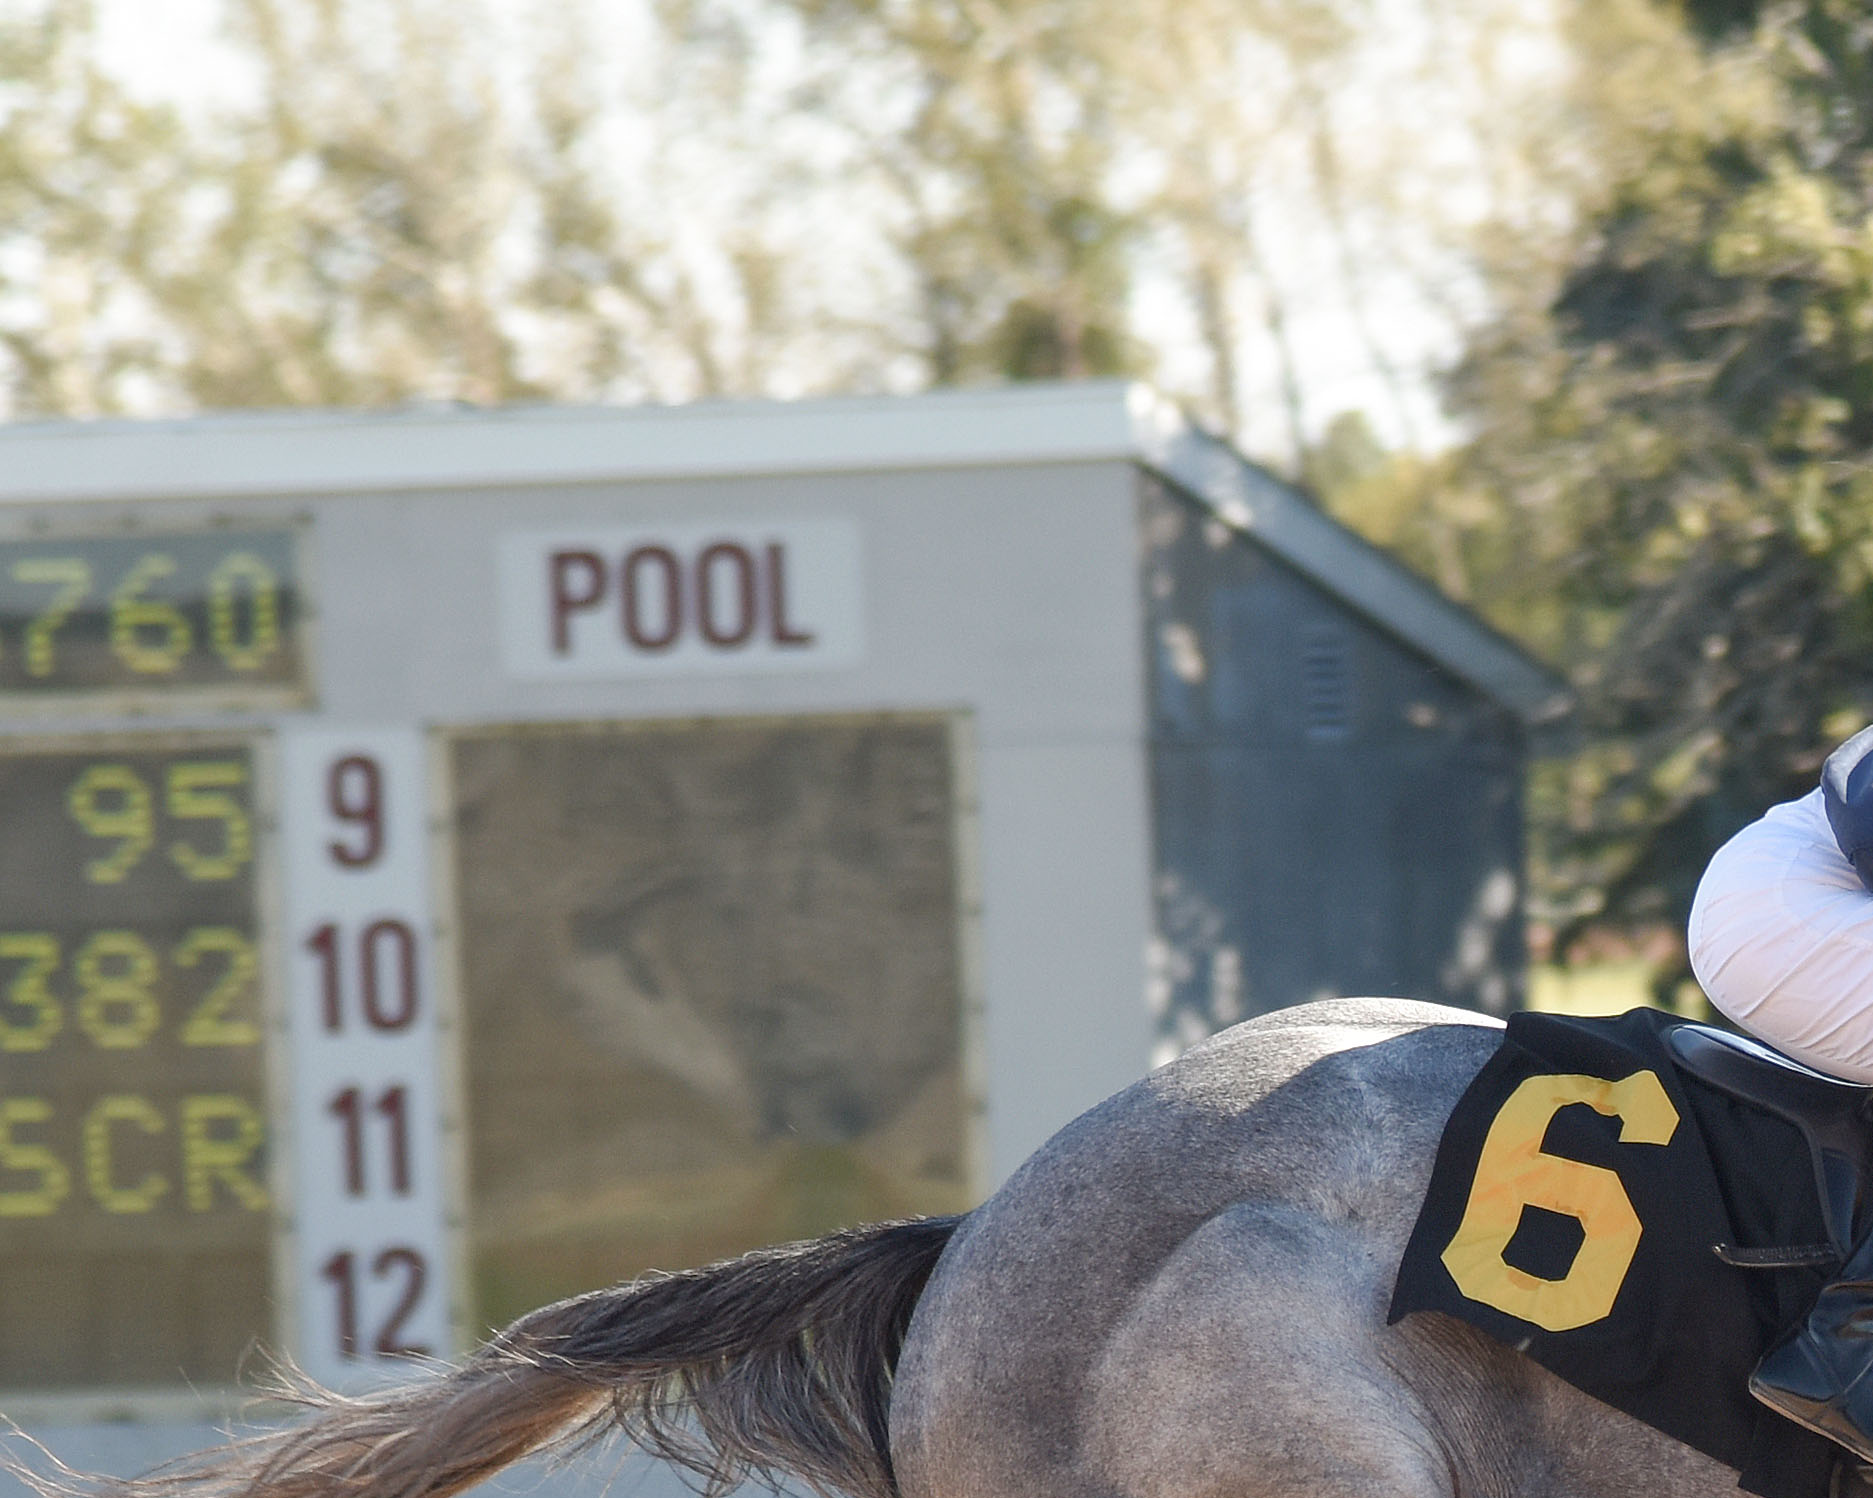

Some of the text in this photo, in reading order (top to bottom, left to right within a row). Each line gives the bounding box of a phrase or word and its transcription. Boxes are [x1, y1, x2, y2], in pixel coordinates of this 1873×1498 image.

[0, 552, 280, 677] 760
[550, 541, 815, 658] POOL
[70, 763, 253, 882] 95
[328, 754, 384, 868] 9
[0, 927, 260, 1051] 382
[306, 919, 418, 1035] 10
[0, 1096, 268, 1214] SCR
[328, 1086, 410, 1197] 11
[1440, 1069, 1681, 1333] 6
[322, 1248, 429, 1361] 12
